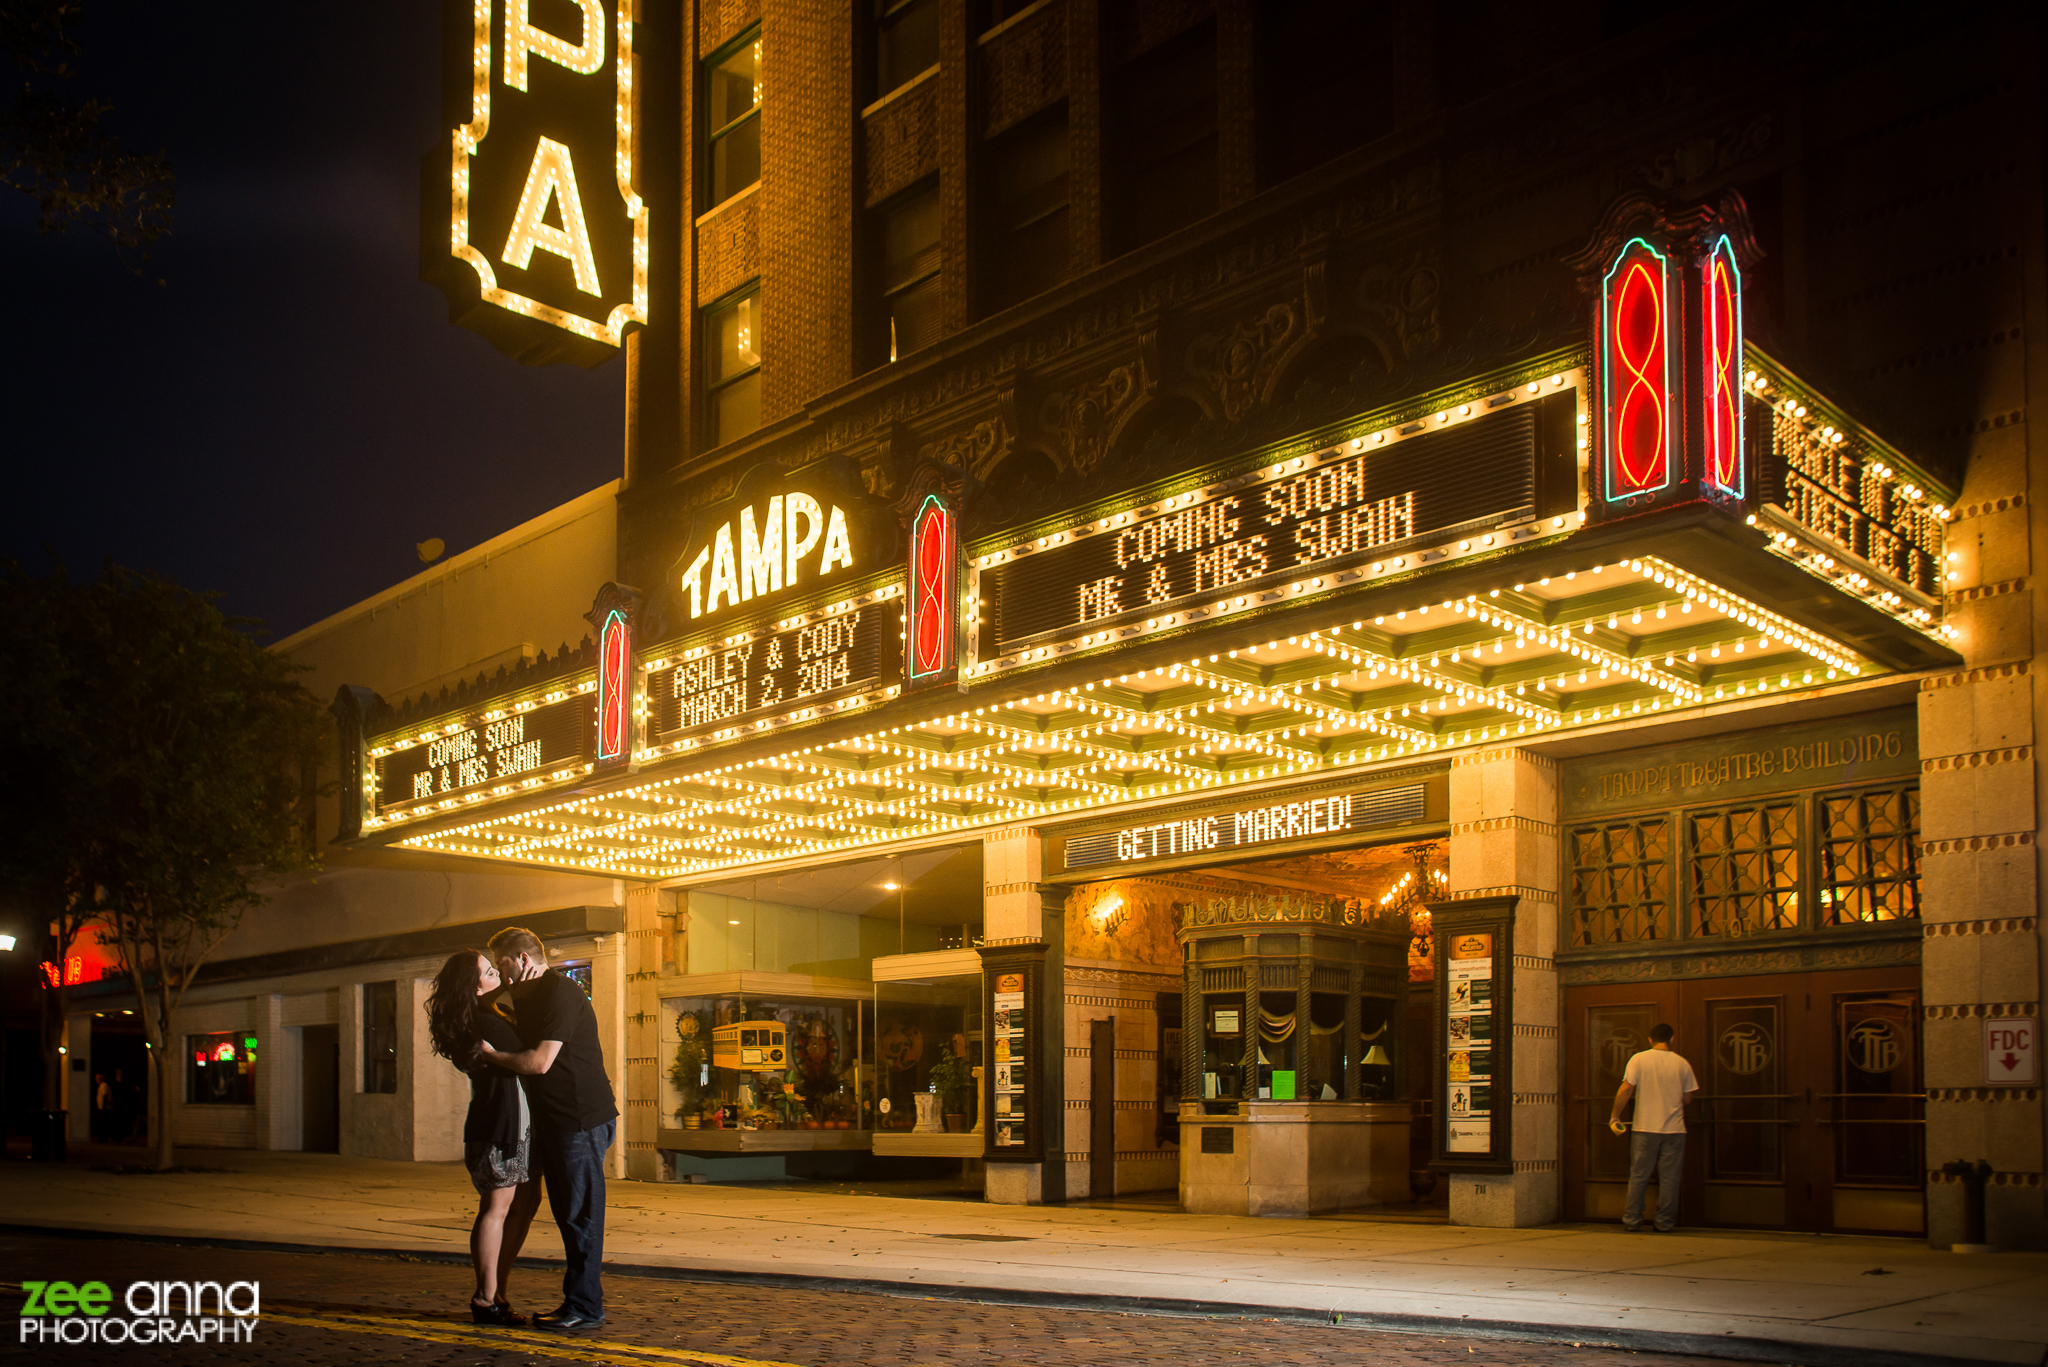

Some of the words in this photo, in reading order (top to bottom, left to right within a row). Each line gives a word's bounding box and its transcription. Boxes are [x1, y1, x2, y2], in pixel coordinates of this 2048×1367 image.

[1116, 495, 1240, 570] COMING
[1264, 457, 1365, 527] SOON
[1784, 470, 1861, 552] STREET
[1859, 471, 1884, 523] ON
[681, 491, 853, 620] TAMPA
[1146, 562, 1171, 605] &
[1195, 534, 1268, 593] MRS
[1294, 490, 1415, 565] SWAIN
[673, 643, 753, 698] ASHLEY
[766, 636, 783, 671] &
[797, 610, 861, 662] CODY
[680, 679, 748, 729] MARCH
[797, 651, 851, 698] 2014
[413, 771, 434, 800] MR
[439, 765, 452, 793] &
[458, 754, 489, 788] MRS
[495, 738, 542, 778] SWAIN
[428, 729, 478, 769] COMING
[485, 714, 524, 752] SOON
[1600, 764, 1673, 800] TAMPA
[1782, 730, 1902, 774] BUILDING
[1117, 815, 1219, 862] GETTING
[1233, 794, 1352, 846] MARRIED!
[1989, 1029, 2030, 1051] FDC
